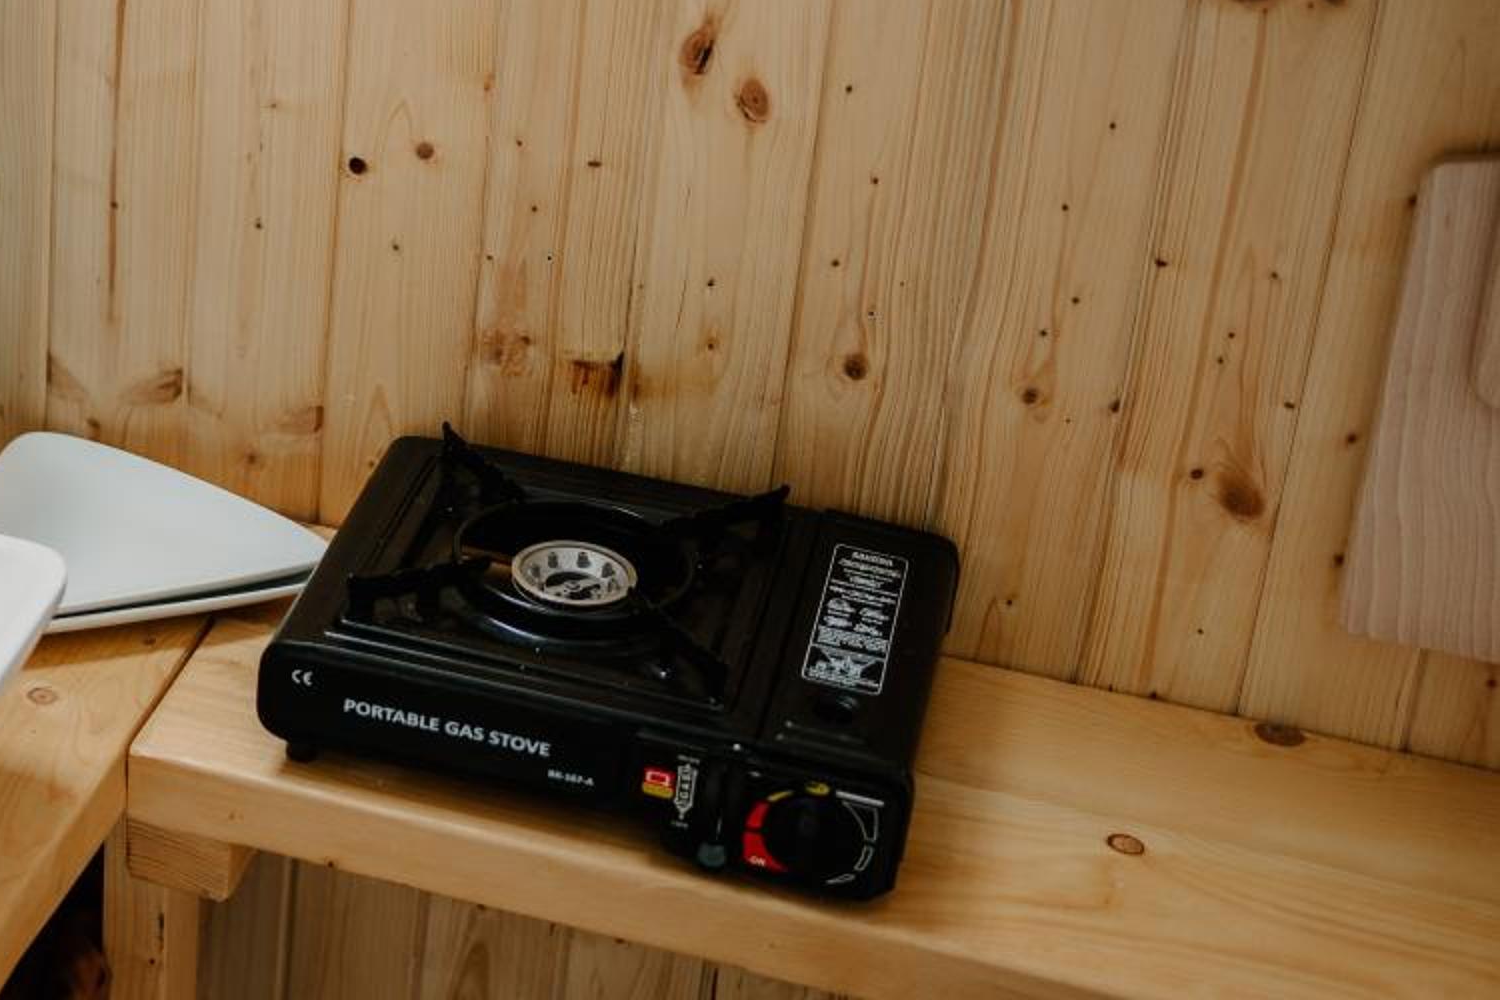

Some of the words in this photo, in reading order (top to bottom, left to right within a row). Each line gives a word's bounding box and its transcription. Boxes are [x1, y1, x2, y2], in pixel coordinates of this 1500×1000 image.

[343, 698, 440, 732] PORTABLE
[445, 720, 485, 742] GAS
[488, 730, 551, 757] STOVE
